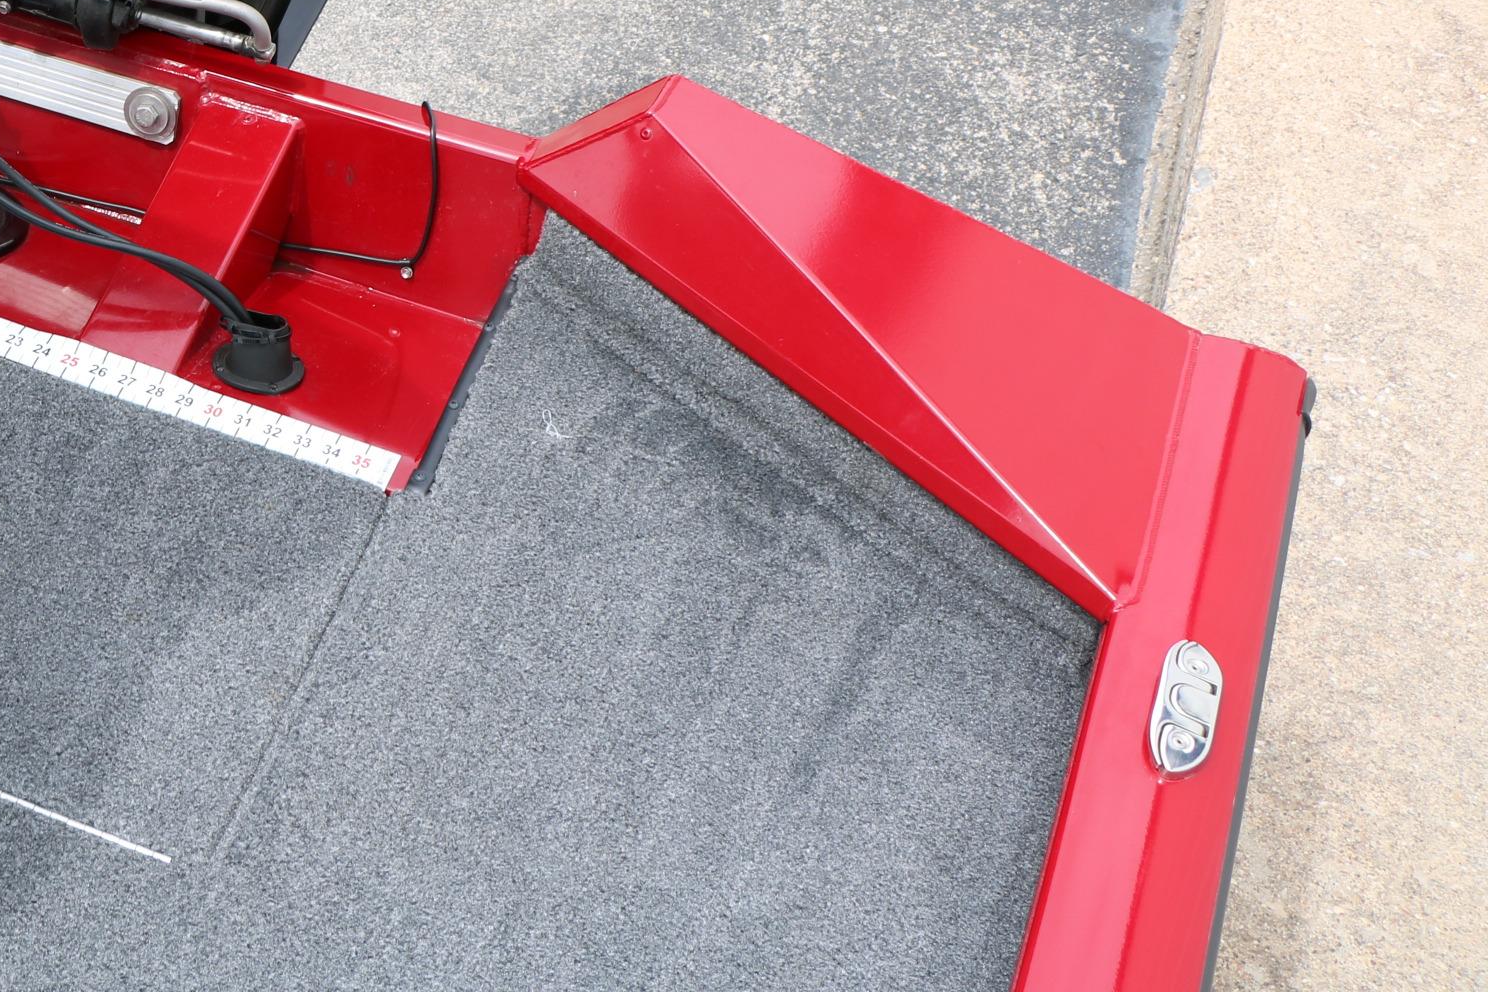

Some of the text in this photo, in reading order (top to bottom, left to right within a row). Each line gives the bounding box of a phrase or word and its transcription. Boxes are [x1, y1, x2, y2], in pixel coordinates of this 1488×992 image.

[5, 334, 23, 346] 23
[32, 344, 50, 356] 24
[60, 354, 79, 367] 25
[89, 364, 107, 377] 26
[117, 375, 136, 387] 27
[146, 384, 164, 397] 28
[175, 395, 193, 407] 29
[204, 405, 222, 417] 30
[234, 415, 251, 428] 31
[263, 424, 282, 437] 32
[293, 435, 311, 448] 33
[322, 445, 341, 458] 34
[352, 455, 371, 468] 35
